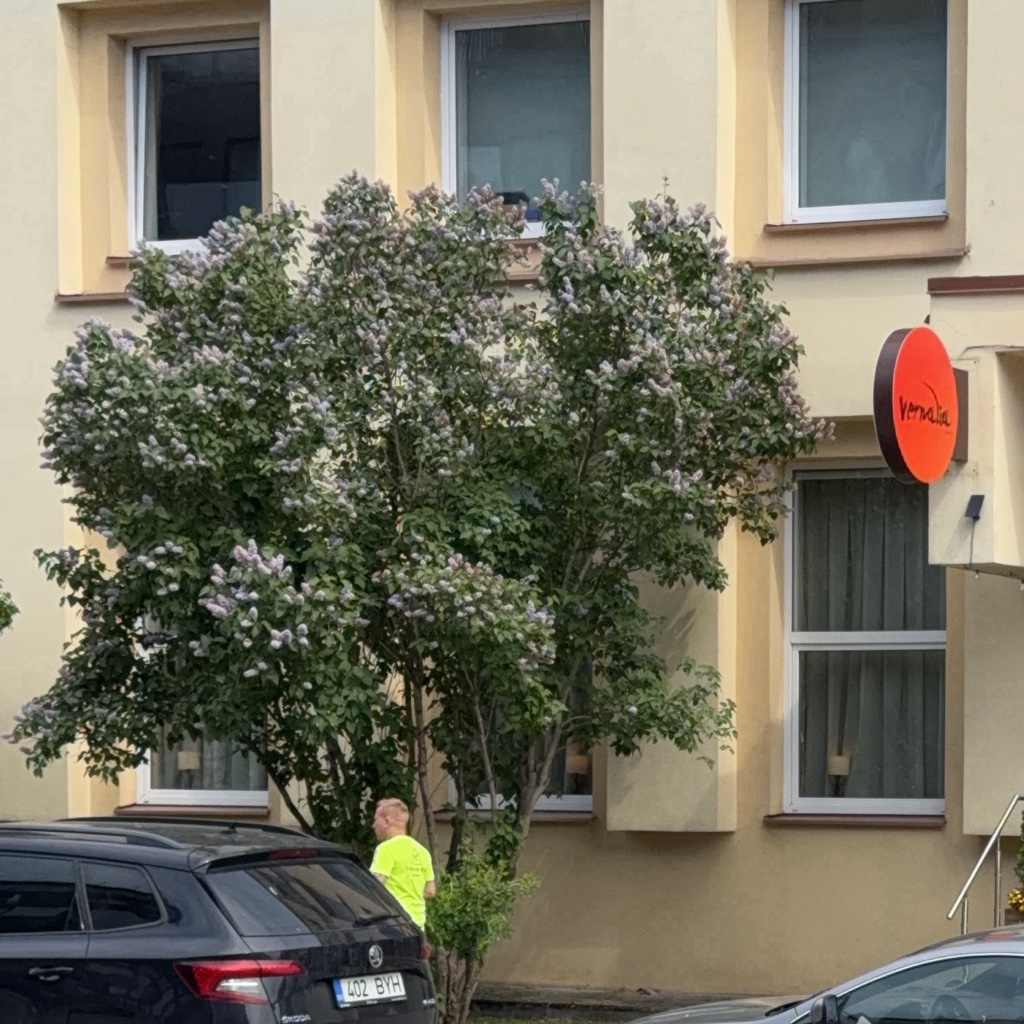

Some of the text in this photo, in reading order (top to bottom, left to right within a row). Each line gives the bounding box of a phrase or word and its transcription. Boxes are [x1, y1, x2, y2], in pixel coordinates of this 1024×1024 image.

[899, 382, 951, 427] Vernalia
[347, 974, 402, 998] 402 BYH
